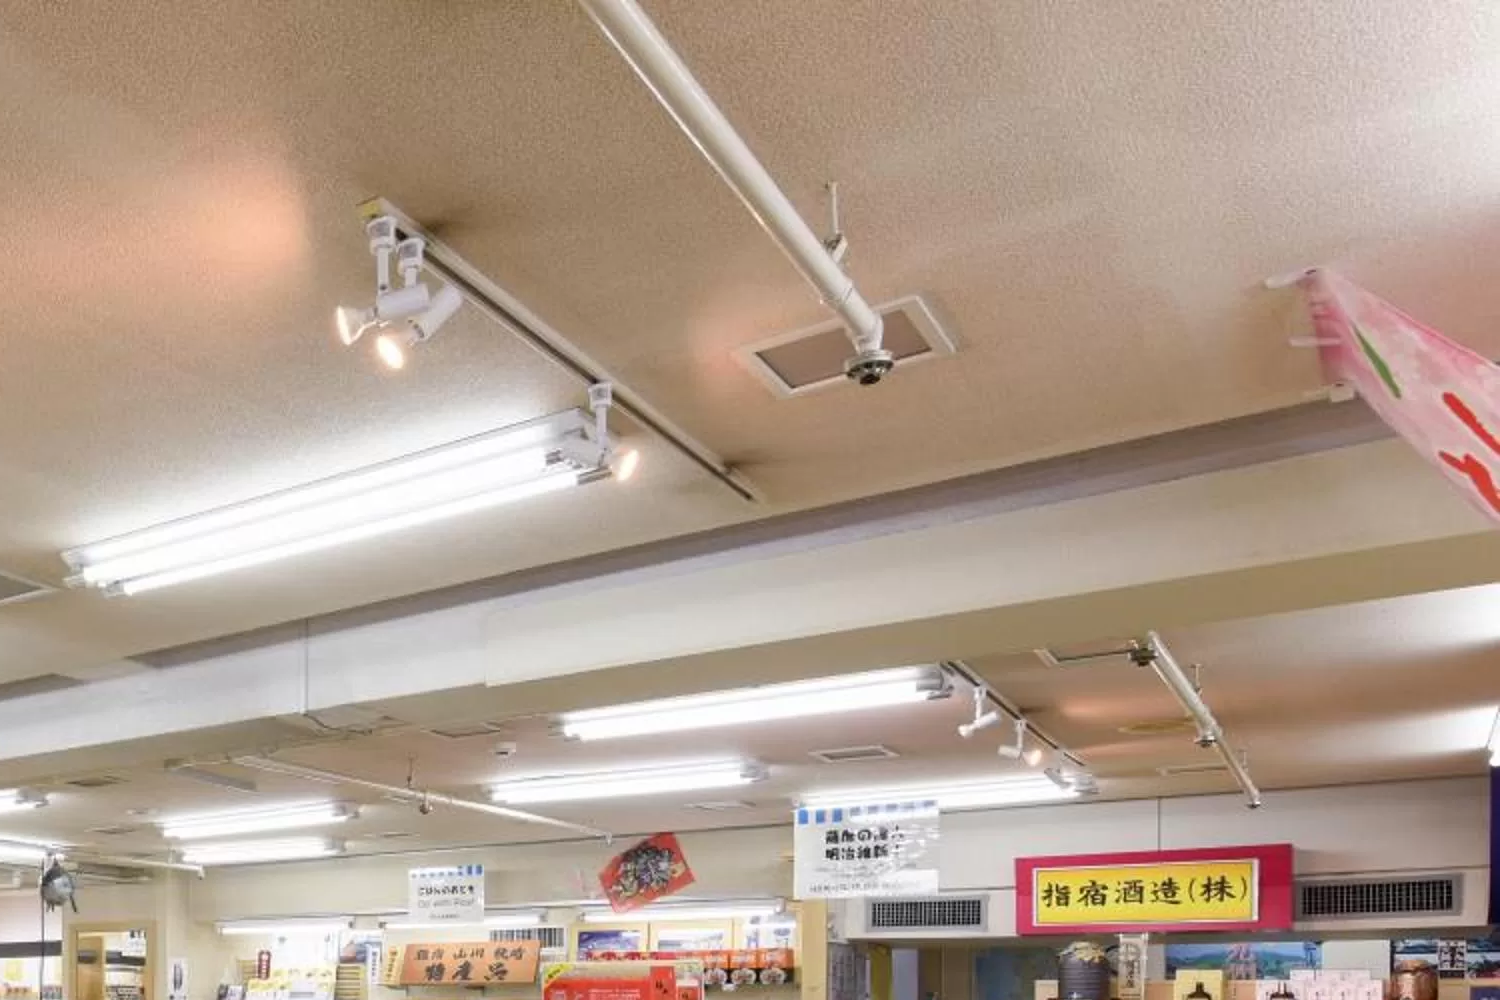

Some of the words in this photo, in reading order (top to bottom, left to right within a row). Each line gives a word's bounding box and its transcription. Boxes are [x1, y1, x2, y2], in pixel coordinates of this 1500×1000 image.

[1041, 875, 1249, 907] 指宿酒造(株)
